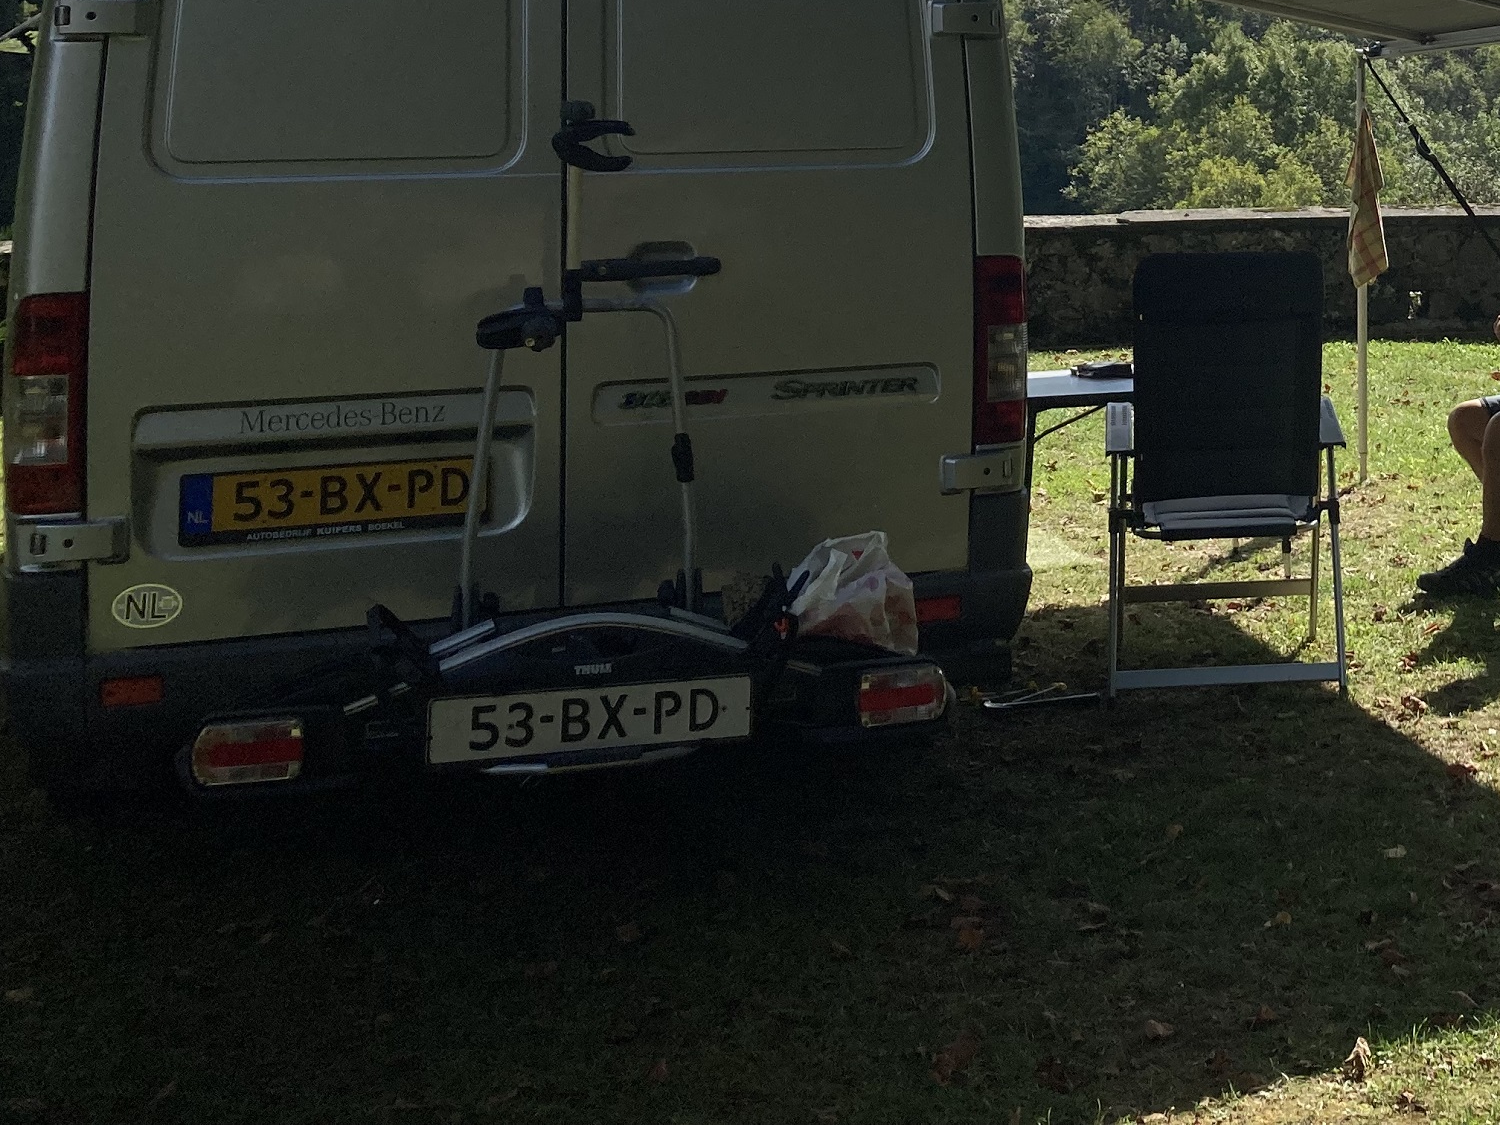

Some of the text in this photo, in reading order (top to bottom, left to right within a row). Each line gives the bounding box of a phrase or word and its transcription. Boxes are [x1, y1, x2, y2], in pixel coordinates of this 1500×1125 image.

[239, 403, 446, 435] Mercedes-Benz
[233, 467, 471, 523] 53-BX-PD
[316, 525, 362, 535] KUIPERS
[125, 592, 168, 620] NL
[469, 688, 719, 751] 53-BX-PD
